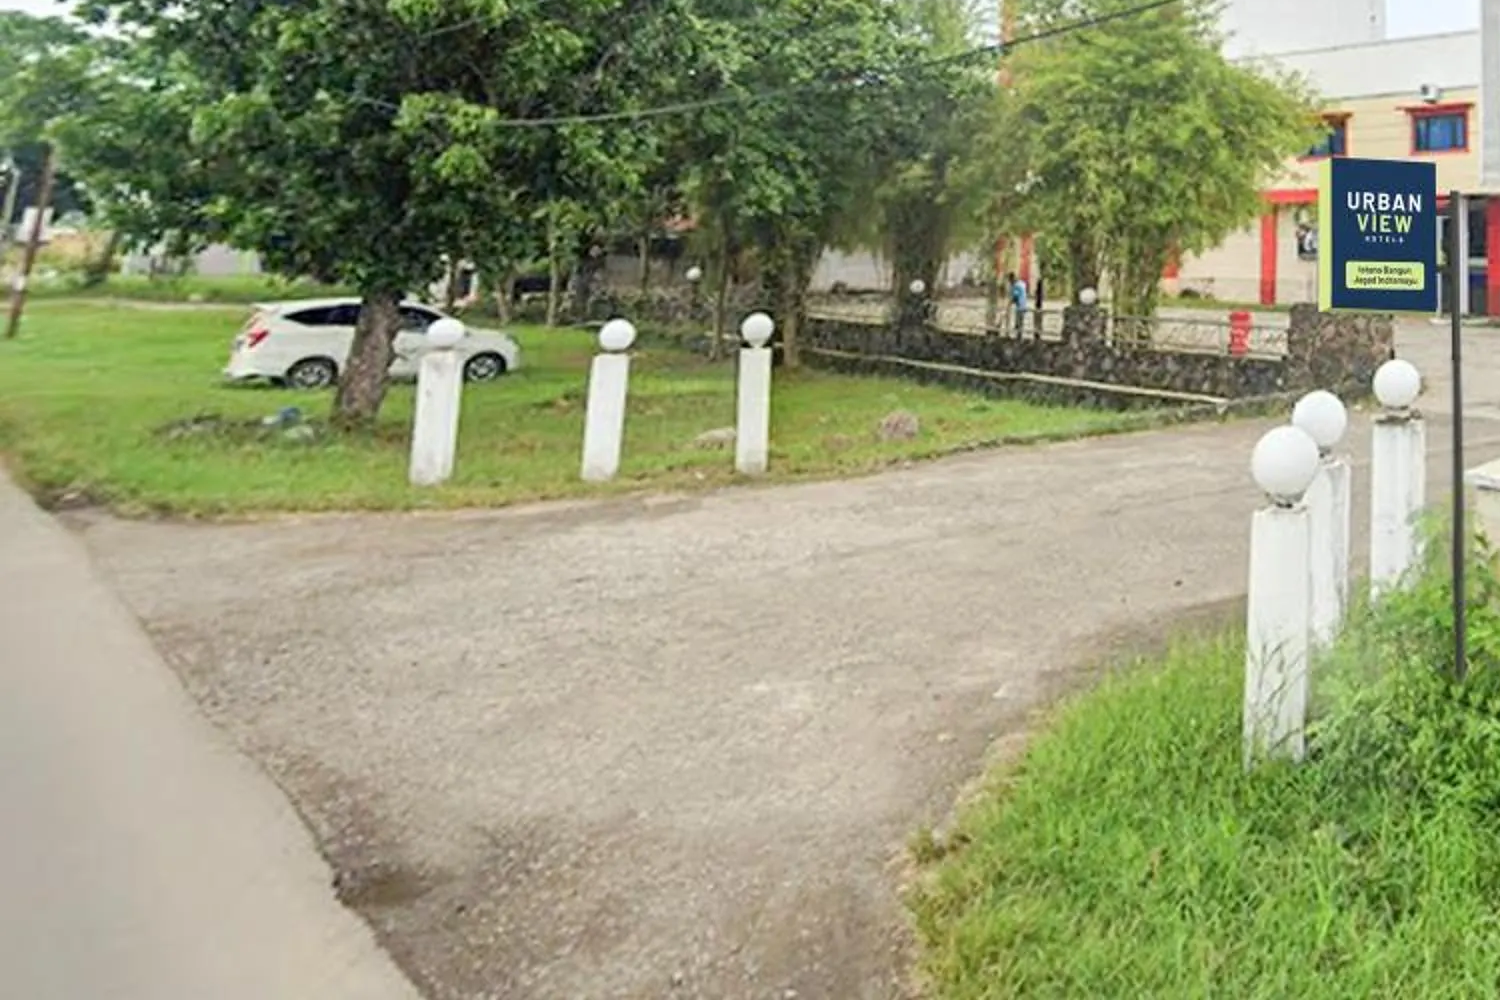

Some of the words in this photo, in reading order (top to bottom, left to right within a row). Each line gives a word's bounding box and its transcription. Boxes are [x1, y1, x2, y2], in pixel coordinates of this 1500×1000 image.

[1347, 191, 1422, 213] URBAN
[1357, 213, 1413, 233] VIEW
[1365, 235, 1404, 243] HOTELS
